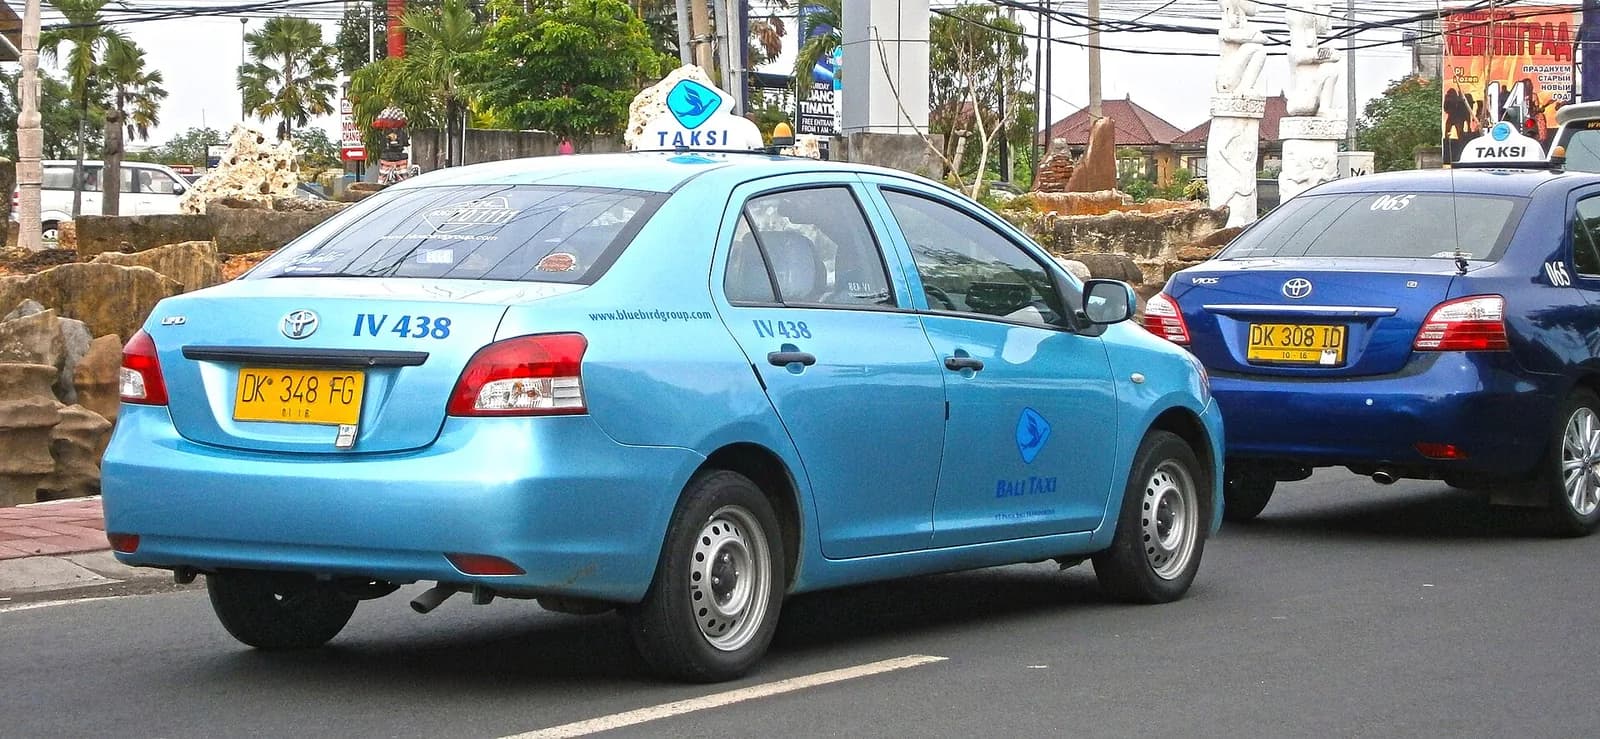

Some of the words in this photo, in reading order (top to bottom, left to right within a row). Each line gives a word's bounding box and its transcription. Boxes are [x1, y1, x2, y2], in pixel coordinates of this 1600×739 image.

[657, 130, 728, 147] TAKSI
[1475, 146, 1526, 158] TAKSI
[1370, 194, 1417, 211] 065
[1192, 277, 1219, 285] VIOS
[1544, 261, 1571, 287] 065
[353, 313, 387, 338] IV
[392, 315, 452, 340] 438
[588, 309, 712, 323] www.bluebirdgroup.com
[752, 319, 774, 338] IV
[777, 320, 812, 340] 438
[1252, 326, 1274, 346] DK
[1281, 326, 1315, 347] 308
[1322, 328, 1342, 348] ID
[241, 373, 268, 402] DK
[279, 375, 319, 403] 348
[329, 375, 355, 405] FG
[995, 479, 1026, 498] BALI
[1029, 476, 1057, 495] TAXI
